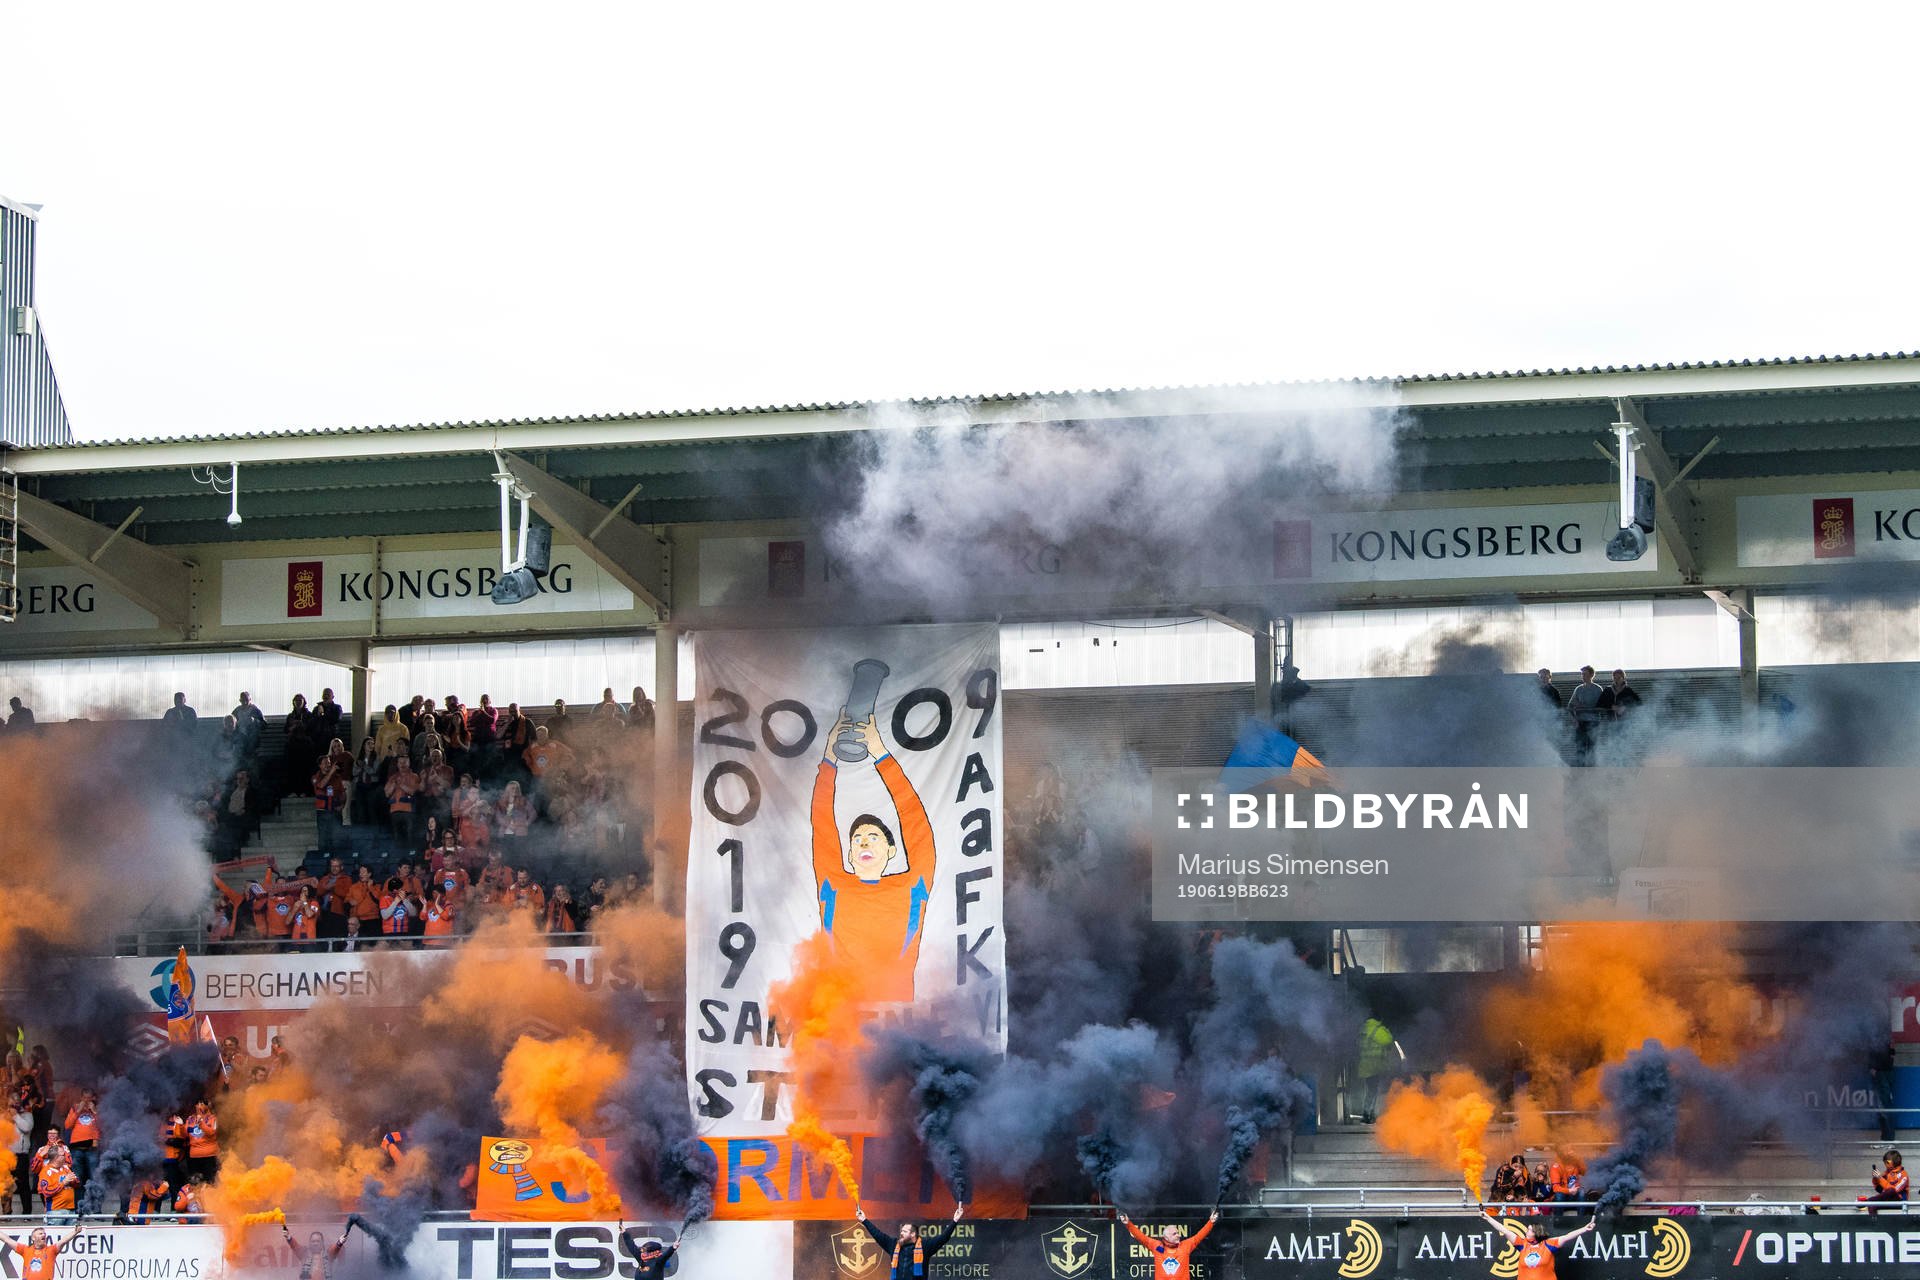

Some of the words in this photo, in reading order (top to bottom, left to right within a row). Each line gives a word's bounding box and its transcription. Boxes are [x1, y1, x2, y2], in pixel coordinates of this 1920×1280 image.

[1330, 523, 1582, 563] KONGSBERG
[339, 563, 573, 602] KONGSBG
[206, 970, 383, 999] BERGHANSEN
[437, 1226, 679, 1279] TESS
[1264, 1232, 1342, 1262] AMFI
[1415, 1231, 1494, 1262] AMFI
[1568, 1230, 1649, 1262] AMFI
[54, 1258, 170, 1279] NTORFORUM
[175, 1258, 199, 1278] AS
[928, 1263, 990, 1277] FFSHORE
